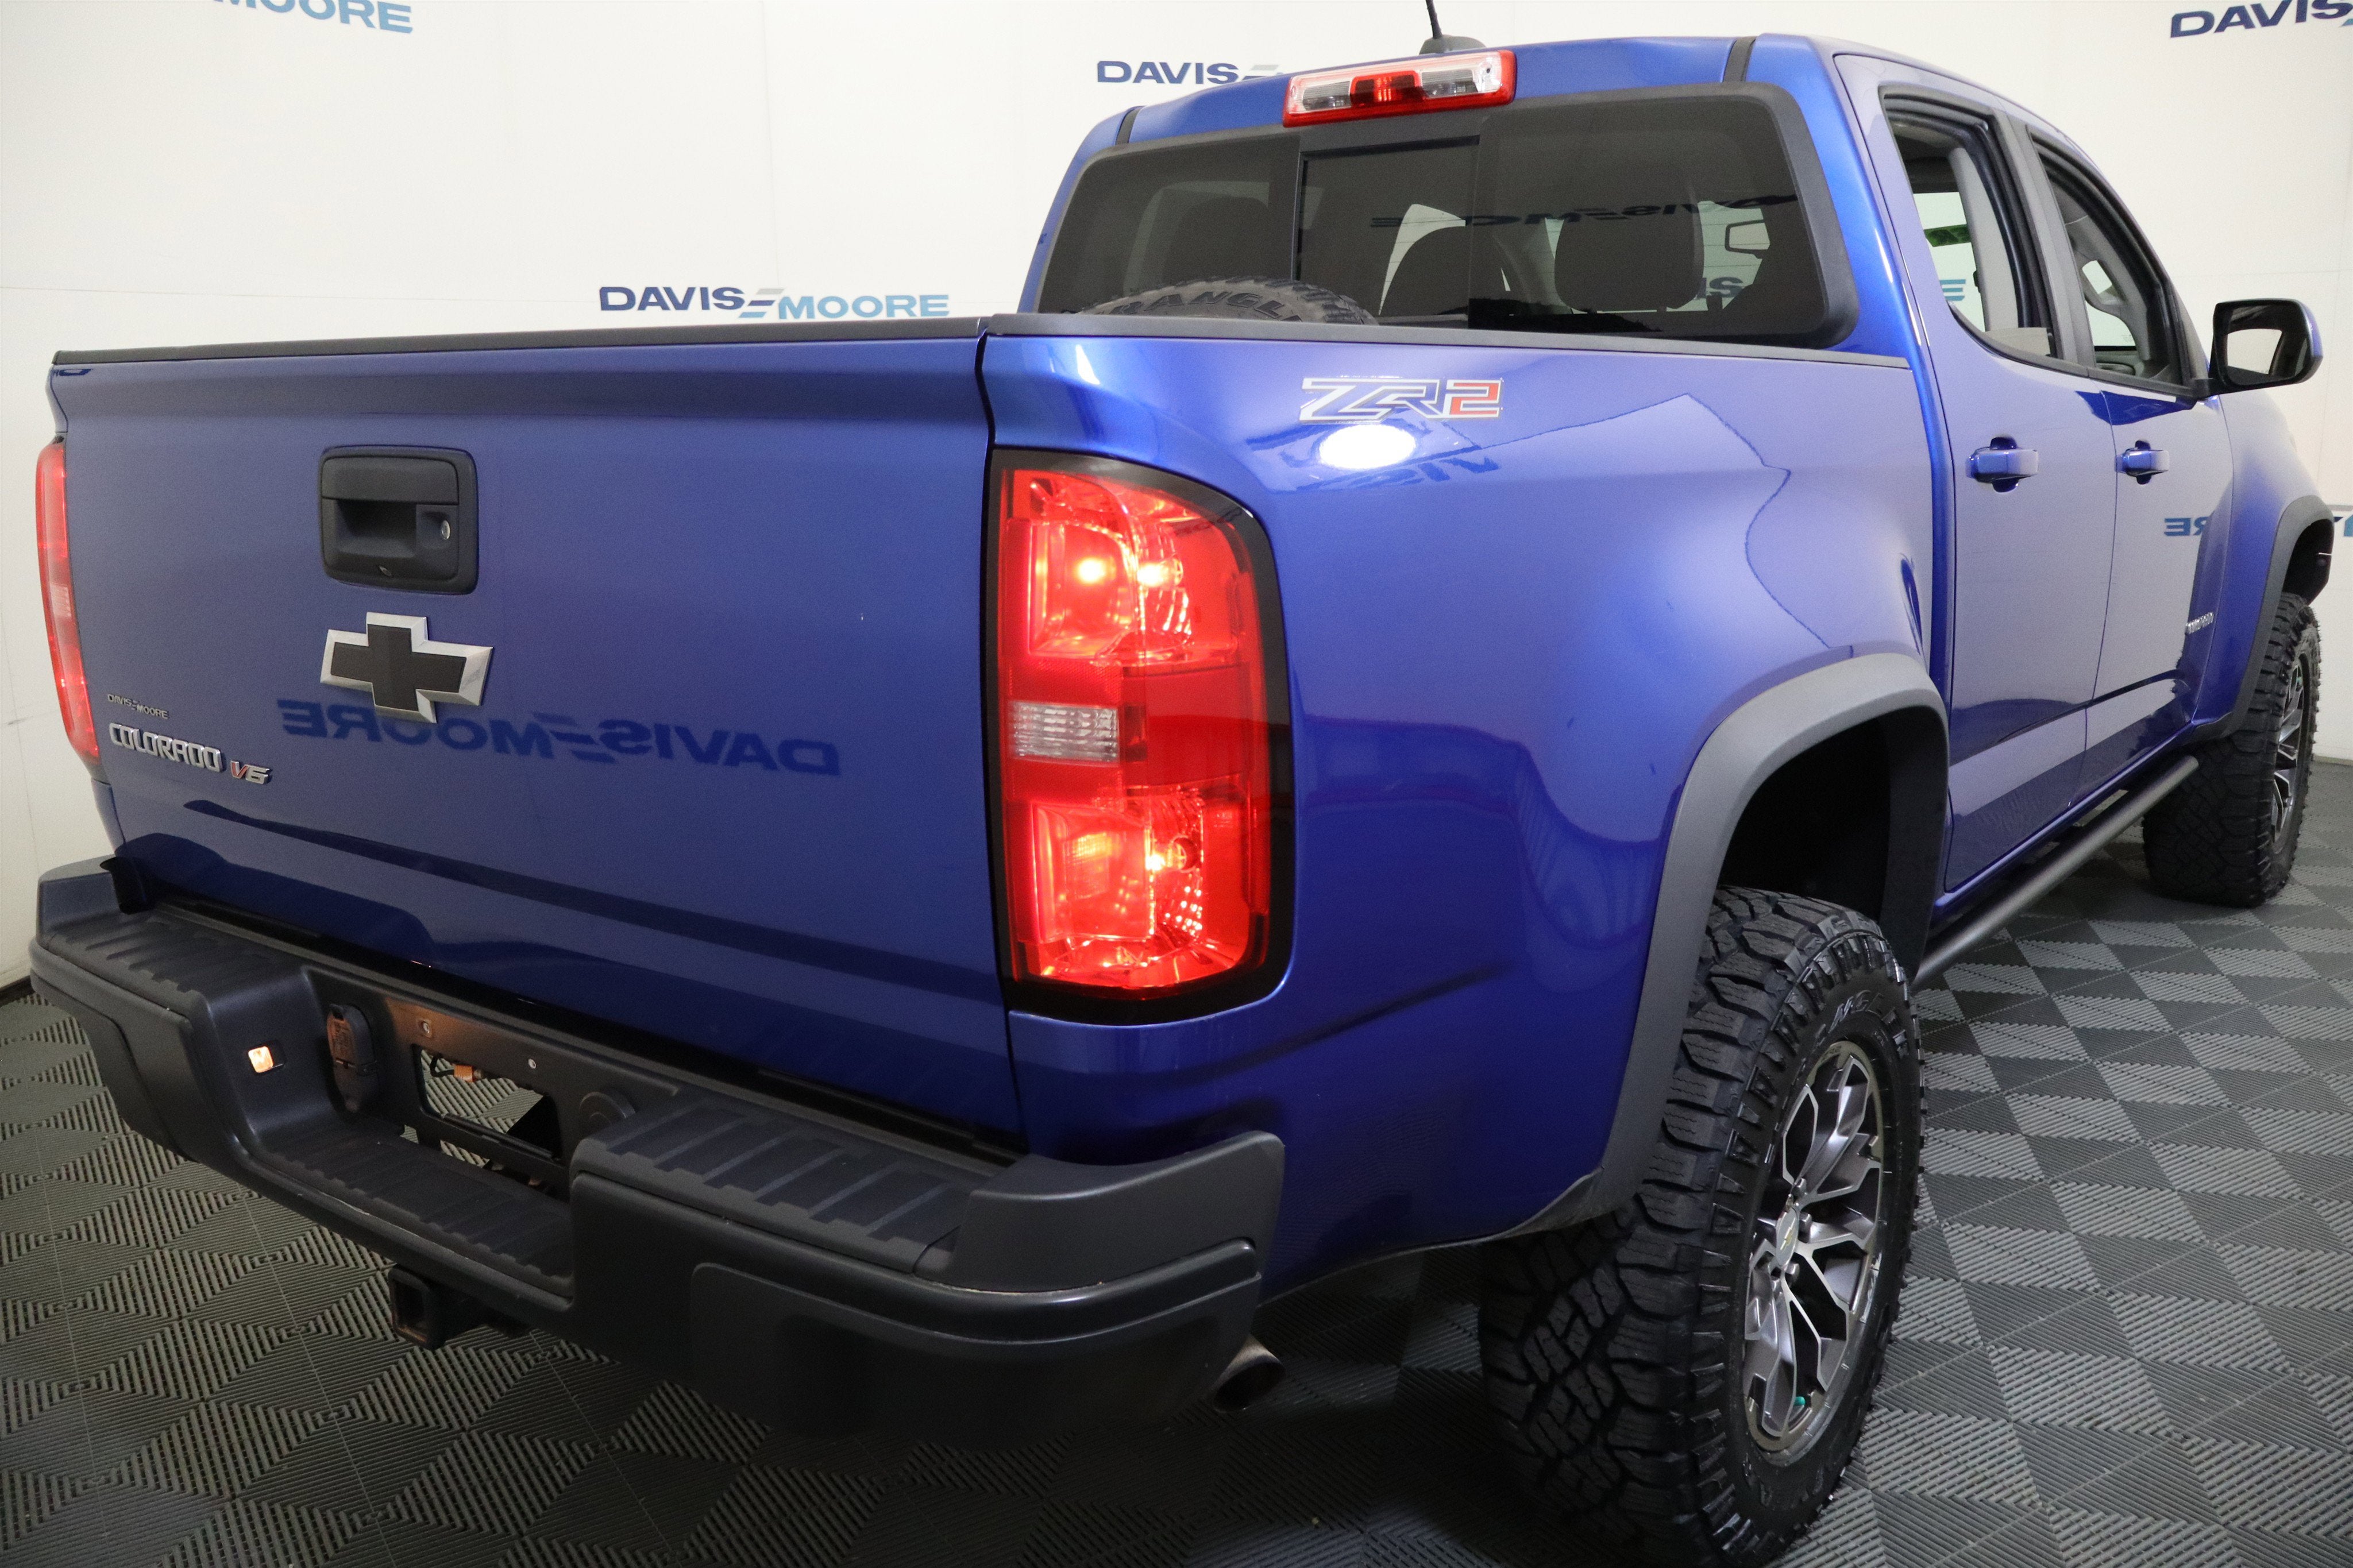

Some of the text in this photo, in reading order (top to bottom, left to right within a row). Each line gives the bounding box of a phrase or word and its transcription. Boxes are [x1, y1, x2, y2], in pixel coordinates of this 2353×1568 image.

[229, 0, 413, 34] ORE
[2170, 0, 2353, 38] DAVIS
[1097, 60, 1240, 84] DAVIS
[599, 287, 950, 319] DAVIS MOORE
[1298, 376, 1503, 424] ZR2
[136, 704, 169, 719] MOORE
[109, 722, 271, 785] COLORADO V6
